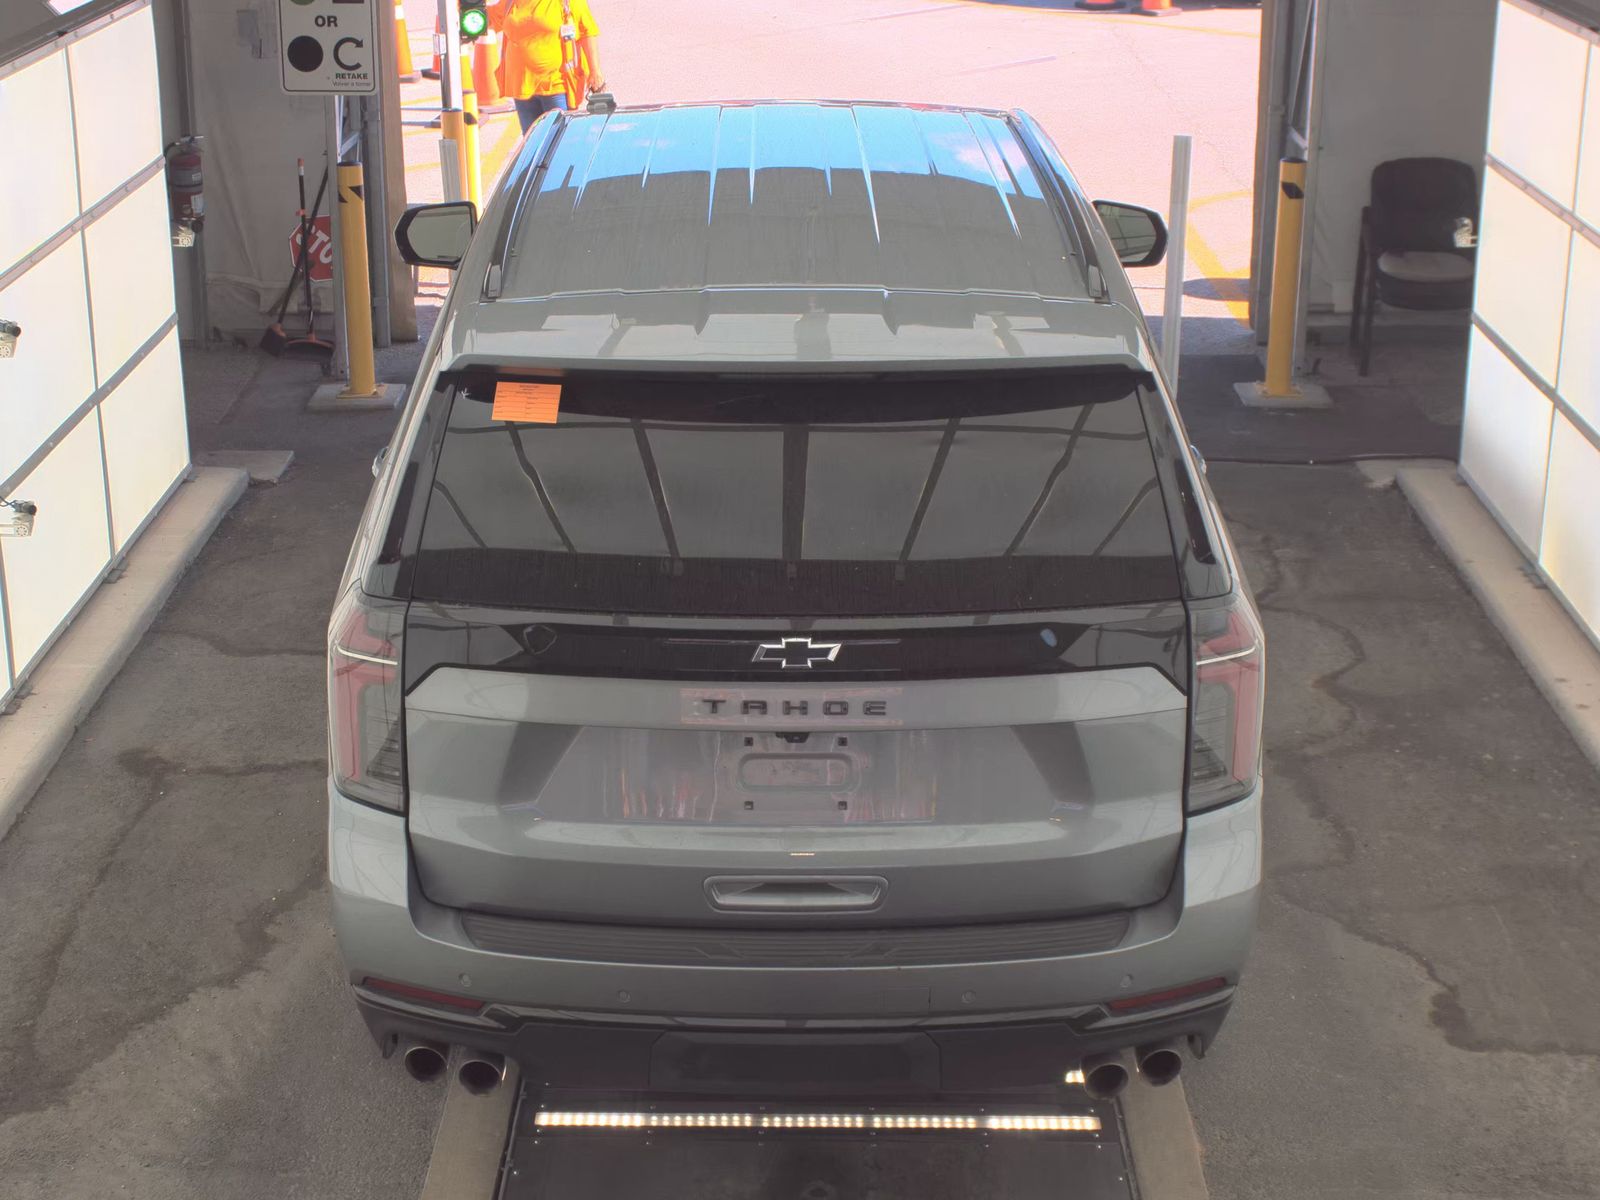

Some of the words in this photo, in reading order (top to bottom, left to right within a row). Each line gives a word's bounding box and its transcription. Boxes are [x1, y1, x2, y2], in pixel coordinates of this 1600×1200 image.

[314, 15, 339, 28] OR
[335, 72, 369, 80] RETAKE
[701, 699, 888, 716] TAHOE
